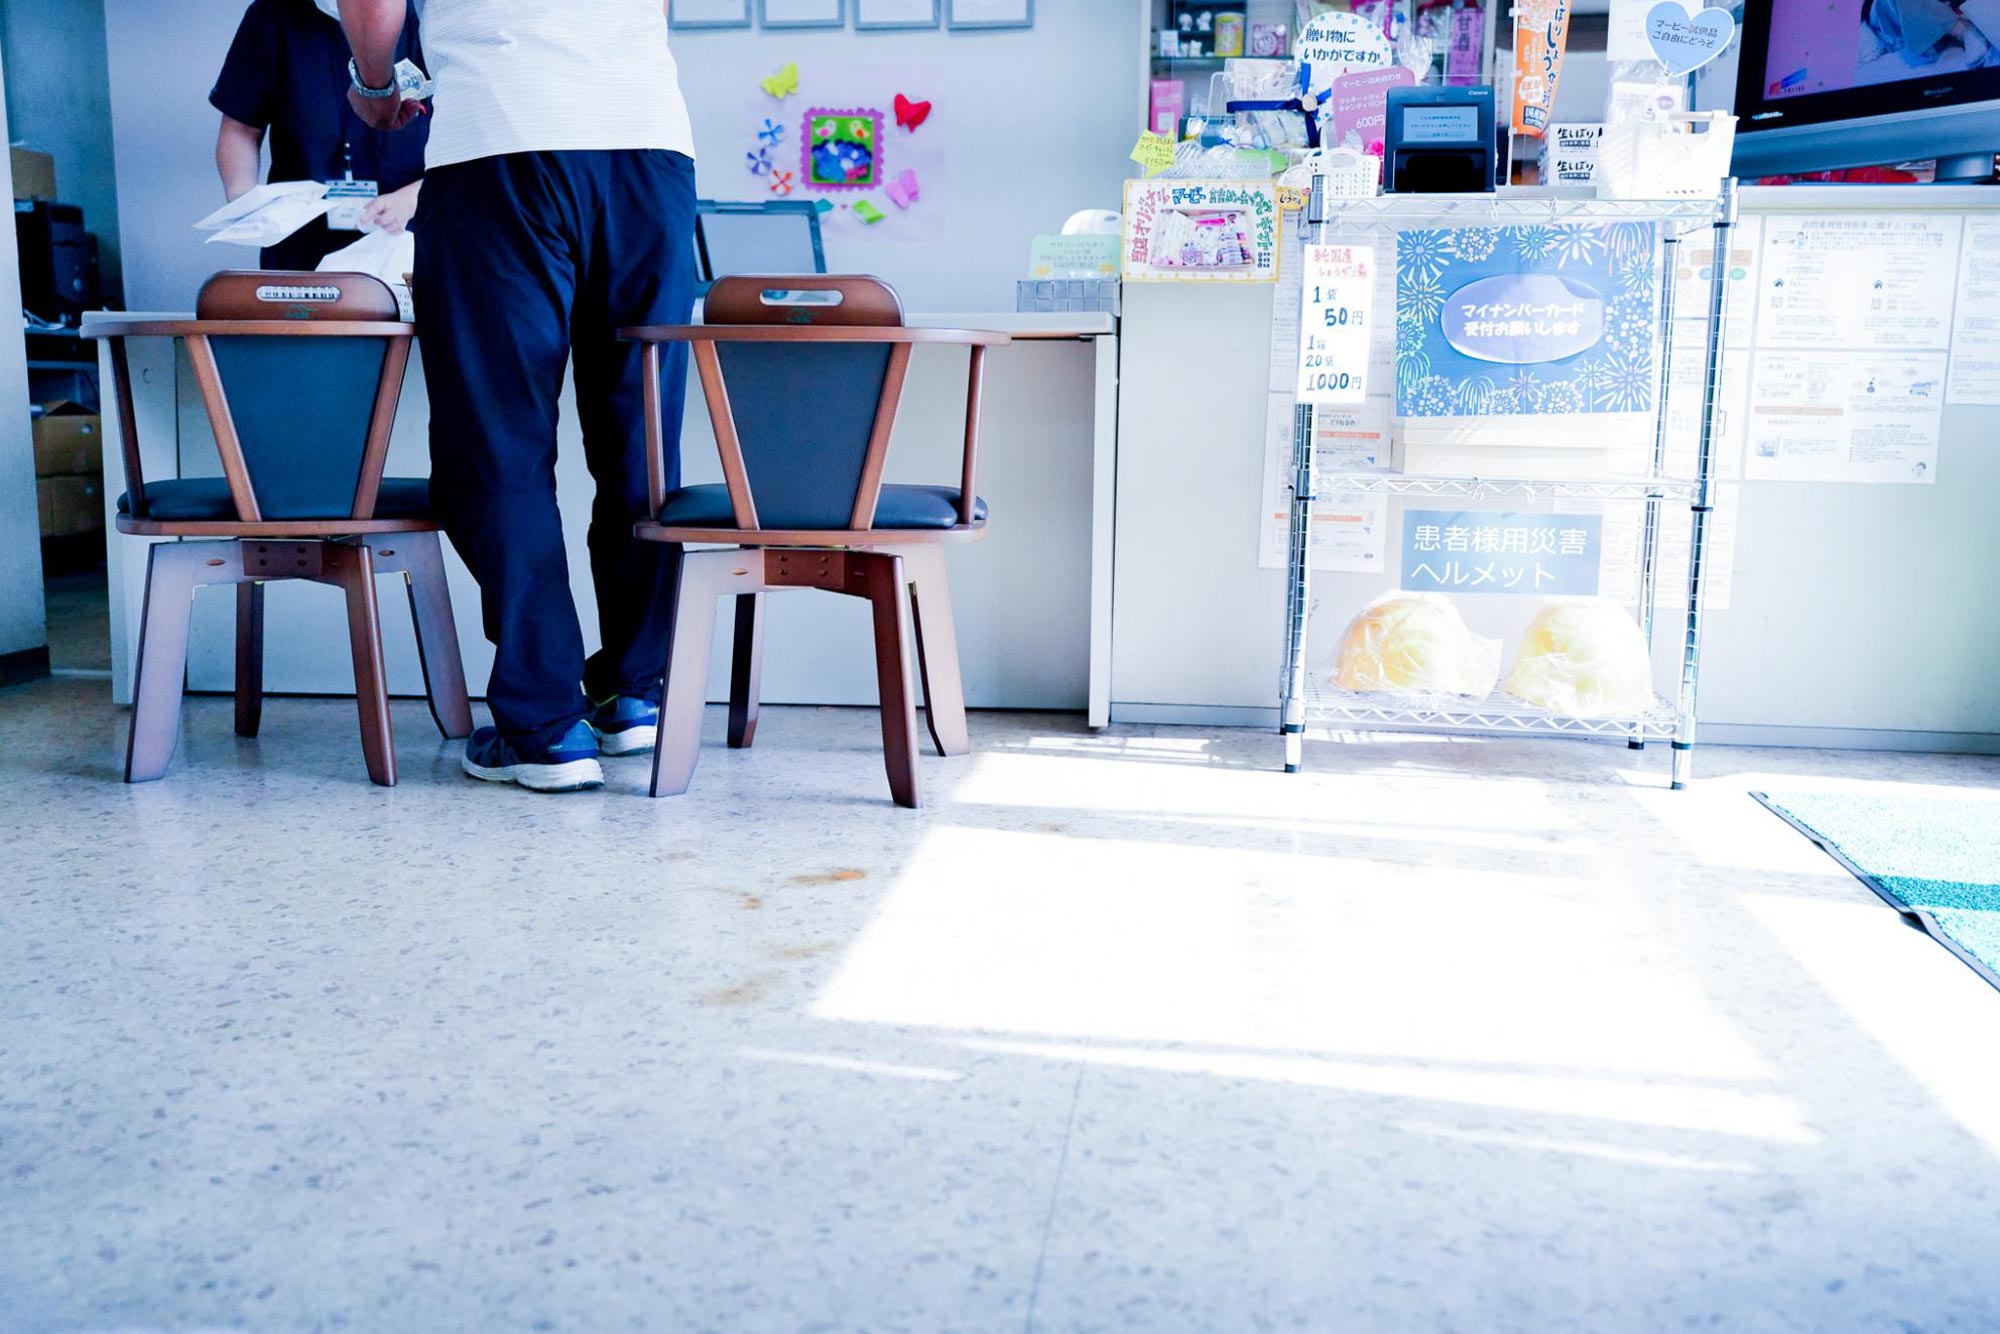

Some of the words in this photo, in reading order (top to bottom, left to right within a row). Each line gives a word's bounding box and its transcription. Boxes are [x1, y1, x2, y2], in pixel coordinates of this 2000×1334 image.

[1305, 28, 1356, 43] 贈り物に
[1656, 19, 1718, 38] マービー試供品
[1652, 30, 1716, 49] ご自由にどうぞ
[1304, 48, 1380, 63] いかがですか
[1557, 127, 1594, 139] 生しぼり
[1557, 160, 1594, 172] 生しぼり
[1171, 186, 1207, 205] マービー
[1324, 307, 1363, 327] 50円
[1461, 302, 1585, 319] マイナンバーカード
[1463, 320, 1582, 337] 受付お願いします
[1306, 373, 1362, 391] 1000円
[1414, 524, 1588, 555] 患者様用災害
[1411, 561, 1555, 589] ヘルメット
